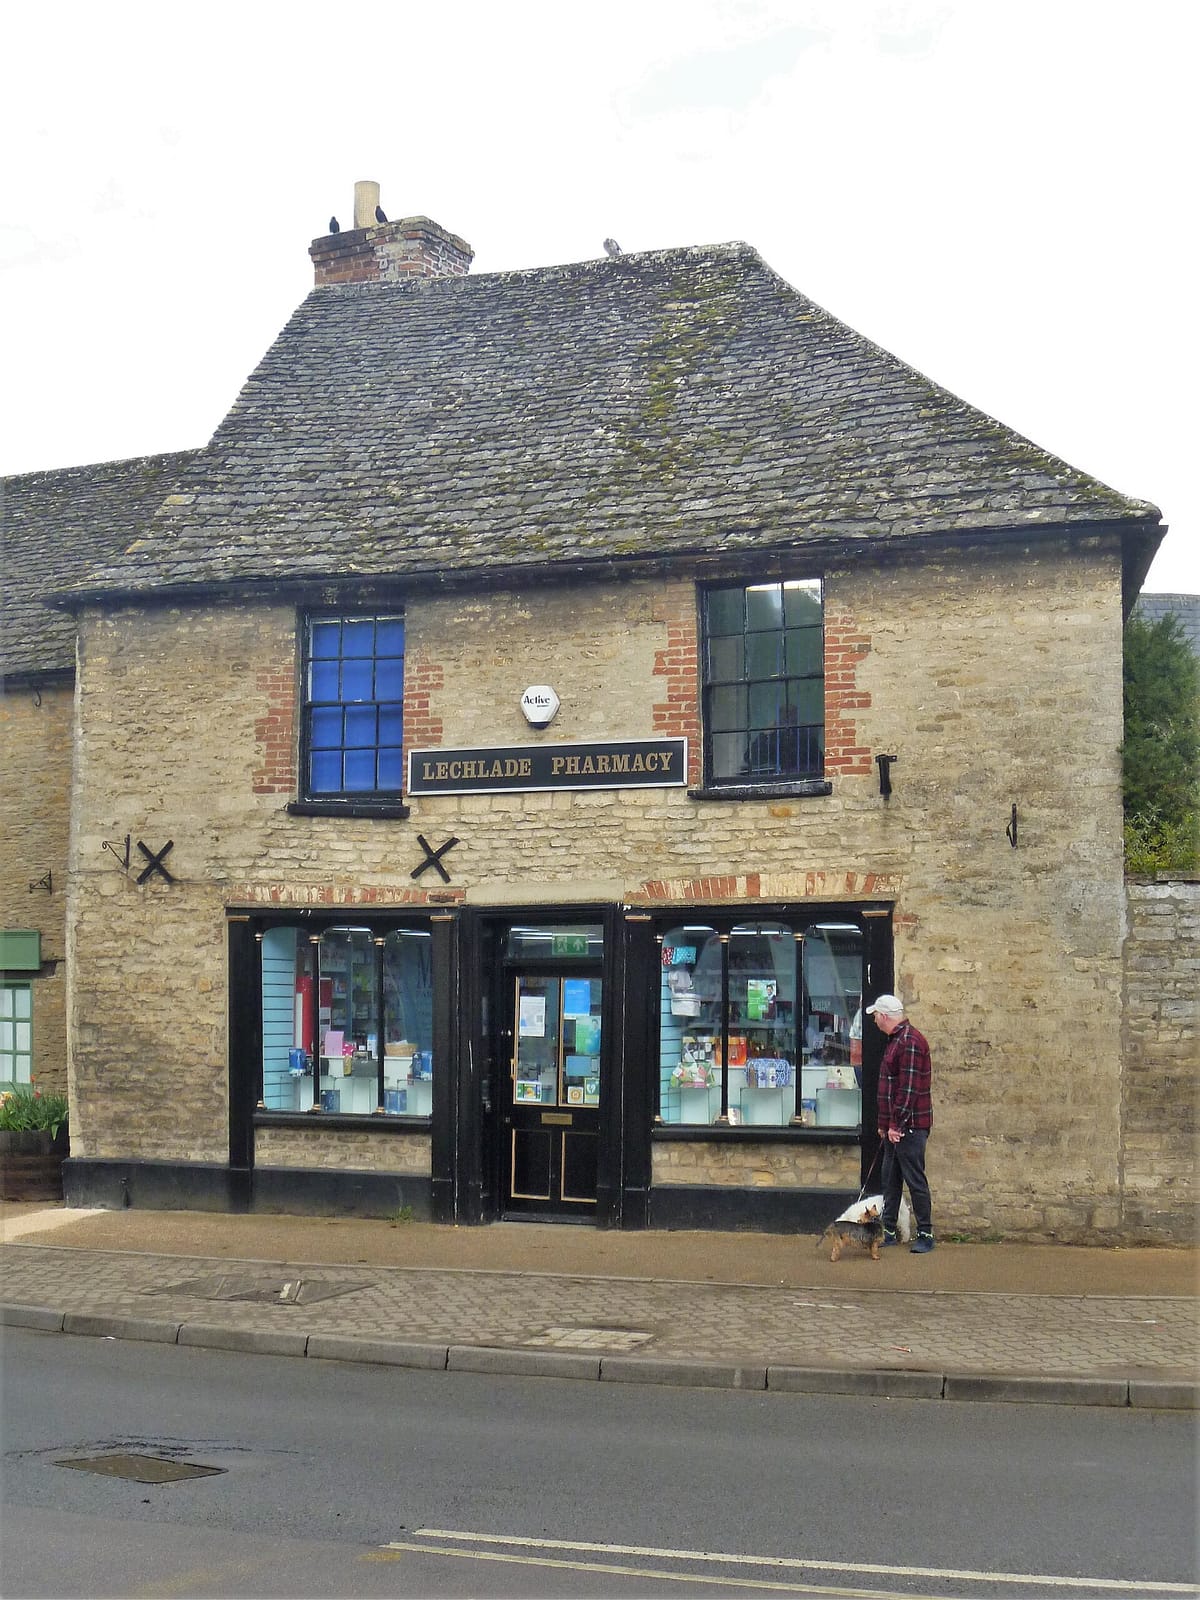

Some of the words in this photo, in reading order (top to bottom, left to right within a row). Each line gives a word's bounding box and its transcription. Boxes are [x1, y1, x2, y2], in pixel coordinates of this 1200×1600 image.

[523, 695, 551, 704] Active
[422, 758, 532, 780] LECHLADE
[551, 751, 674, 775] PHARMACY
